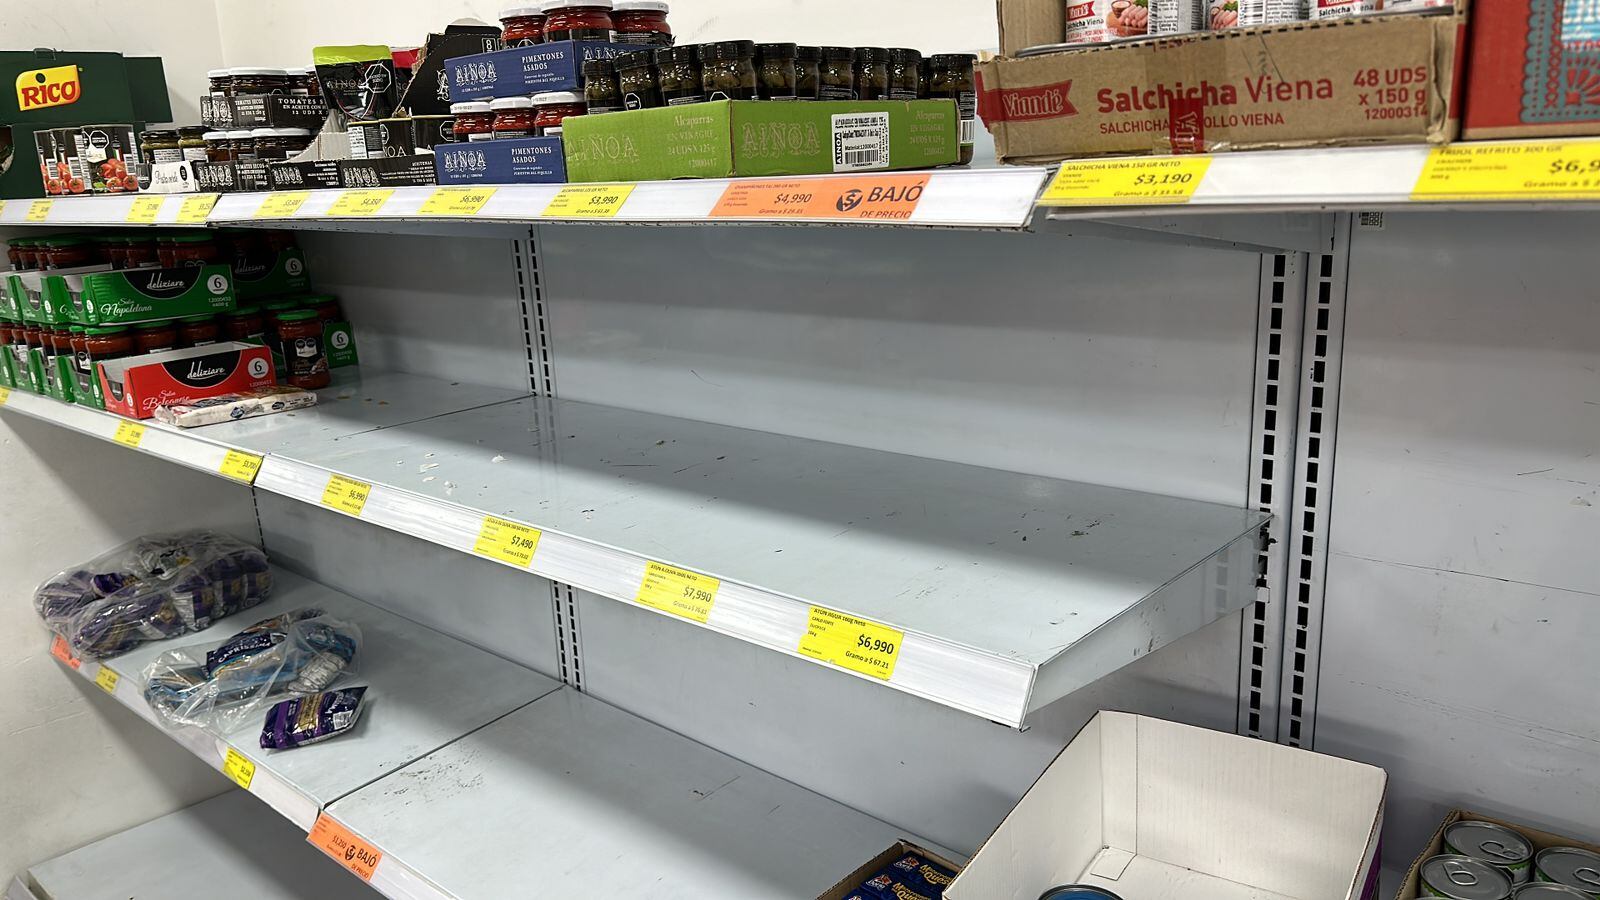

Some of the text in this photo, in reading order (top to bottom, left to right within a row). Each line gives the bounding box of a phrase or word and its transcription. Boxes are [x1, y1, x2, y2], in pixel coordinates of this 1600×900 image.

[1318, 5, 1351, 17] Salchicha
[521, 51, 565, 64] PIMENTONES
[523, 63, 548, 72] ASADOS
[1352, 66, 1428, 88] 48 UDS
[1002, 75, 1333, 118] Viandé Salchicha Viena
[1358, 89, 1427, 106] x 150 g
[1364, 105, 1429, 120] 12000314
[673, 115, 714, 128] Alcaparras
[1100, 113, 1285, 134] SALCHICHA OLLO VIENA
[511, 146, 552, 155] PIMENTONES
[1475, 146, 1521, 155] REFRITO
[512, 156, 537, 164] ASADOS
[1066, 163, 1106, 171] SALCHICHA
[1134, 173, 1192, 186] $3,190
[867, 181, 924, 202] BAJÓ
[588, 196, 619, 205] $3,990
[774, 193, 812, 204] $4,990
[876, 210, 912, 218] PRECIO
[290, 260, 297, 271] 6
[146, 273, 185, 290] deliziare
[213, 277, 222, 289] 6
[336, 333, 344, 344] 6
[187, 361, 226, 380] deliziare
[254, 362, 263, 373] 6
[511, 534, 534, 549] $7,490
[683, 586, 712, 602] $7,990
[857, 633, 894, 655] $6,990
[845, 650, 863, 661] Gramo
[873, 658, 889, 669] 67.21
[356, 848, 378, 868] BAJÓ
